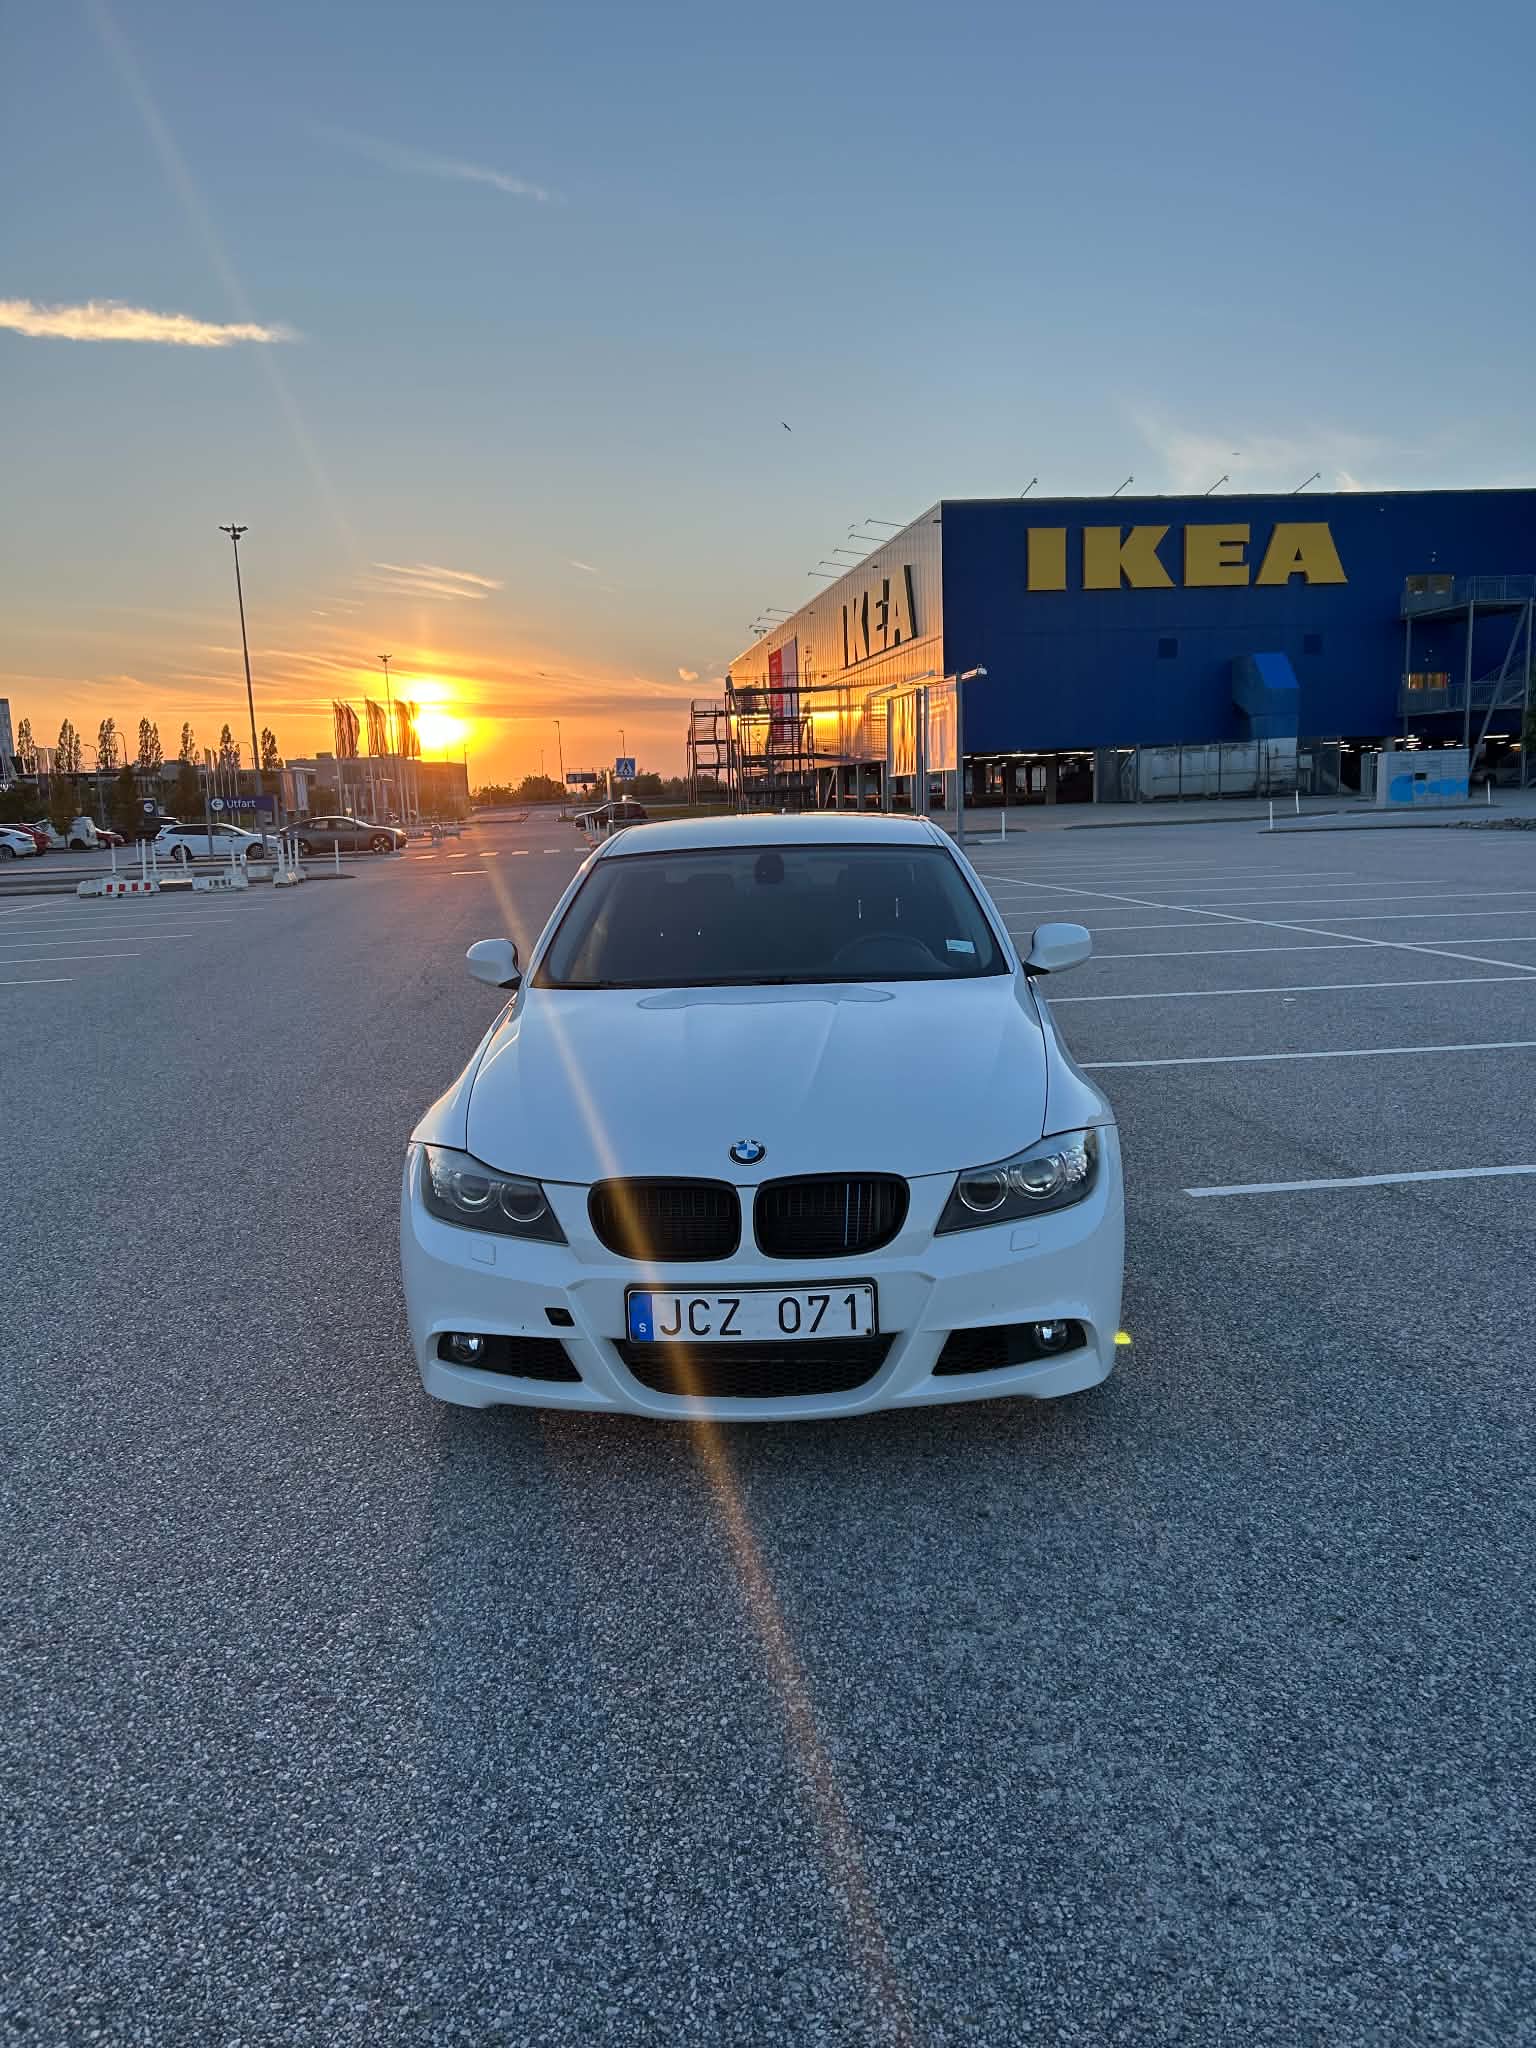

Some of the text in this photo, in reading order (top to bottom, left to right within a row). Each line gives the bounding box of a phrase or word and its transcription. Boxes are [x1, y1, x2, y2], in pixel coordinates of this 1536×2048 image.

[1027, 522, 1348, 591] IKEA
[838, 564, 918, 669] IKEA
[226, 799, 257, 809] Utfart
[638, 1323, 648, 1333] S
[660, 1293, 857, 1336] JCZ 071
